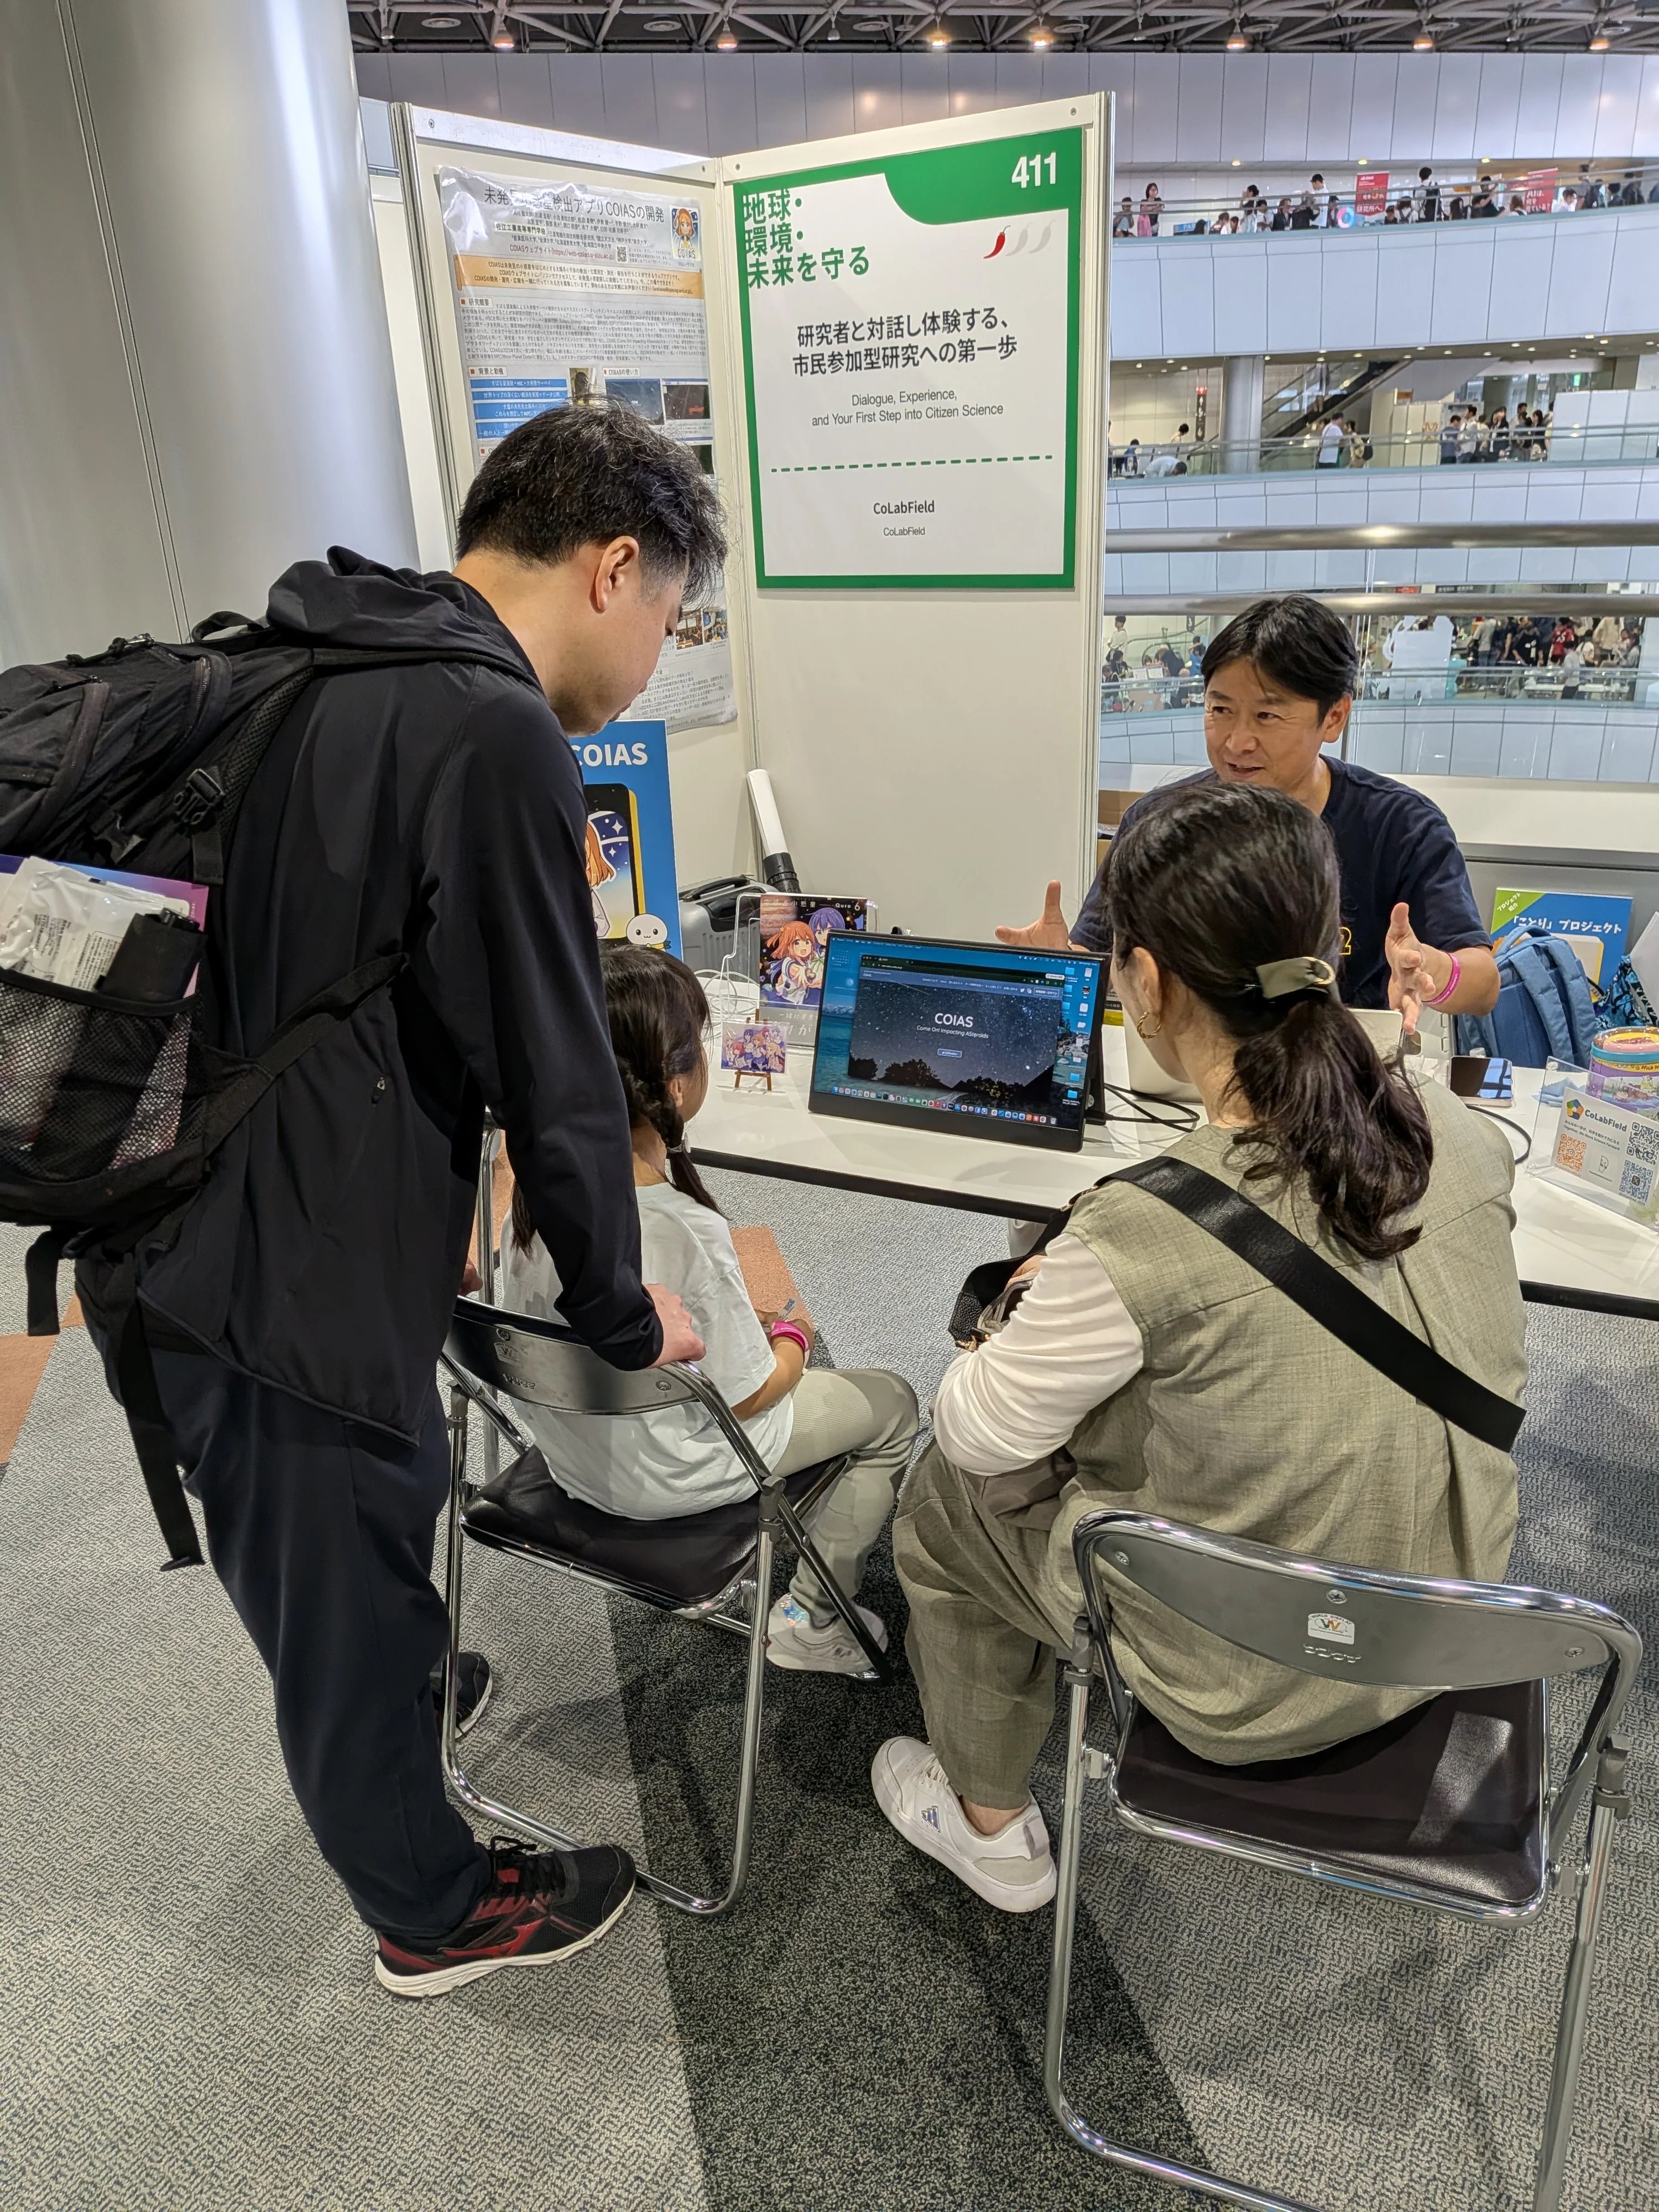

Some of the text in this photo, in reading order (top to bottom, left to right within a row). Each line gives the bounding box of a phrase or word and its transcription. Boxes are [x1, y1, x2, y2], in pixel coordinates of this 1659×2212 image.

[1010, 152, 1057, 189] 411
[747, 246, 870, 289] 未来を守る
[797, 307, 1009, 348] 研究者と対話し体験する、
[792, 335, 1018, 377] 市民参加型研究への第一歩
[852, 389, 957, 406] Dialogue, Experience,
[812, 404, 1004, 426] and Your First Step into Citizen Science
[873, 500, 935, 515] CoLabField
[883, 526, 925, 537] CoLabField
[854, 902, 860, 911] 6
[1496, 893, 1521, 911] プロジェクト
[1514, 916, 1622, 934] 「ことり」 プロジェクト
[935, 1013, 973, 1027] COIAS
[941, 1028, 964, 1037] Impacting
[1585, 1109, 1627, 1132] CoLabField
[1564, 1124, 1579, 1134] Together,
[1593, 1136, 1606, 1145] Science
[1606, 1141, 1620, 1151] Forward
